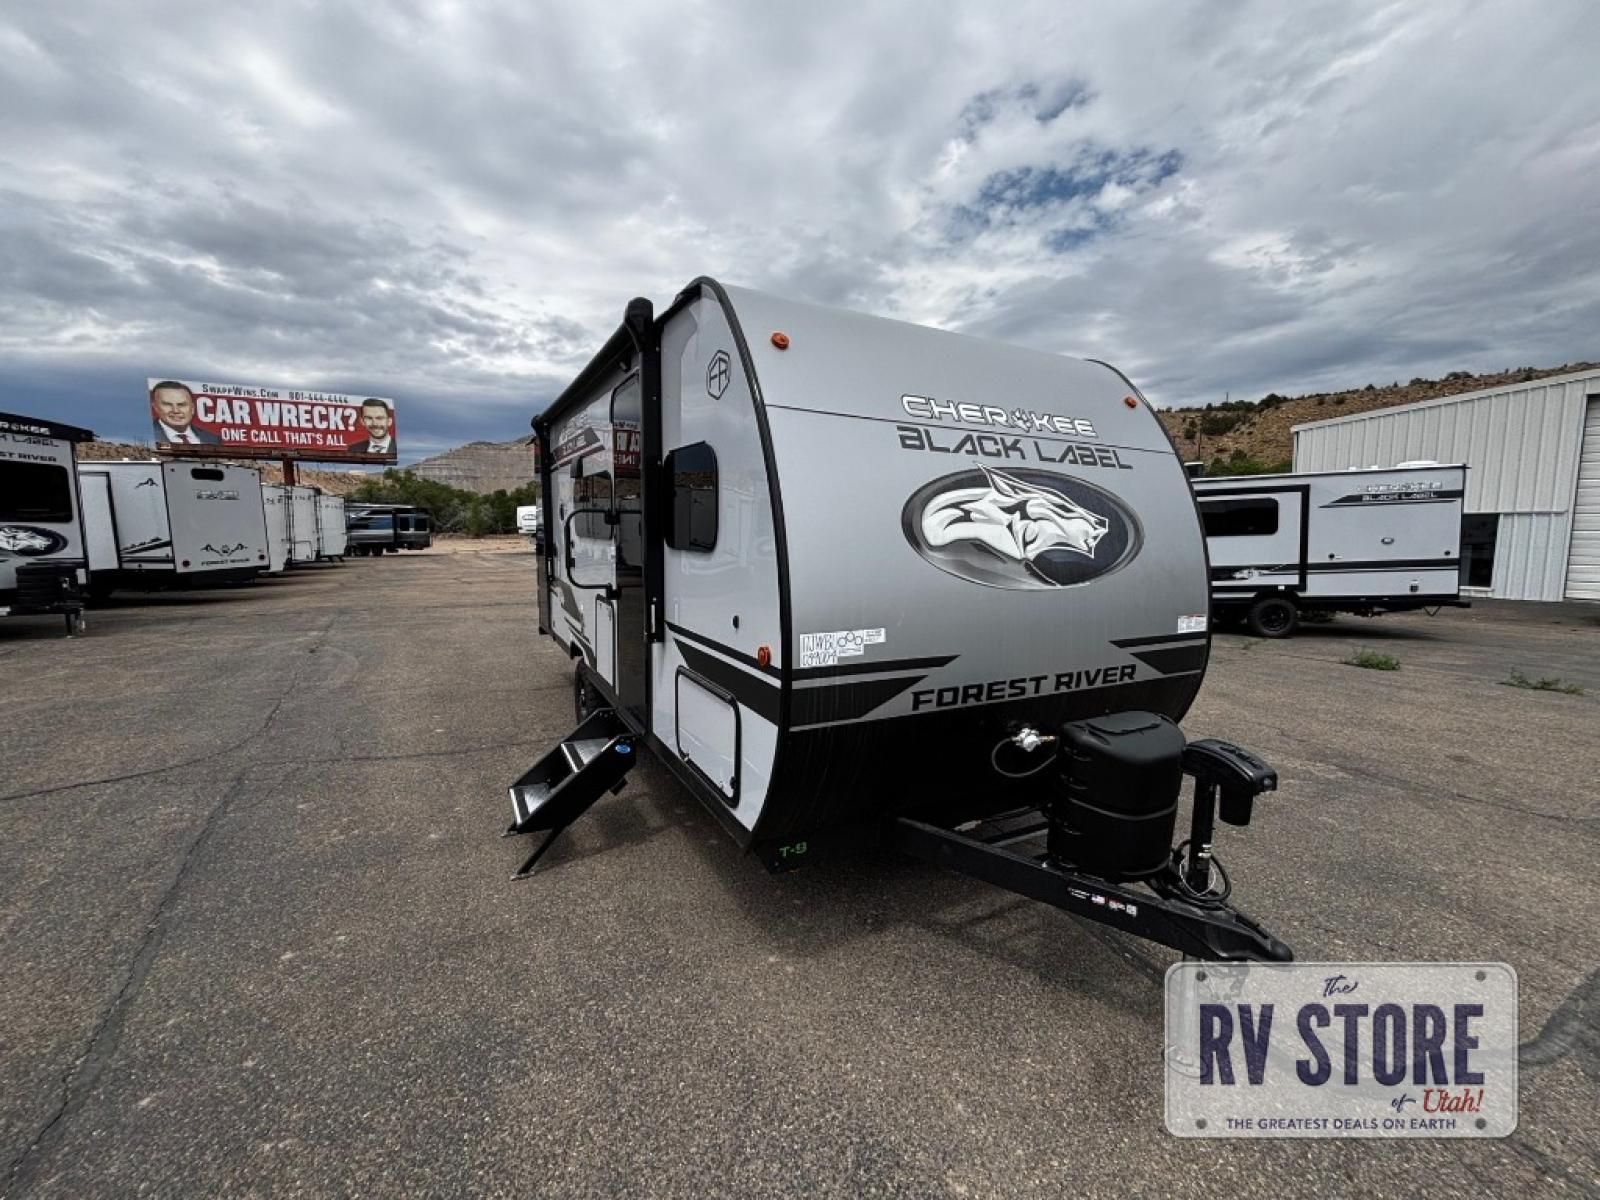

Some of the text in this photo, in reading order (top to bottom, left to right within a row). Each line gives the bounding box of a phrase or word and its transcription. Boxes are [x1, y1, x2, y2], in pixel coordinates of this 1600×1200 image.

[196, 396, 357, 432] CAR WRECK?
[221, 428, 348, 446] ONE CALL THAT'S ALL
[897, 425, 1133, 470] BLACK LABEL
[911, 664, 1137, 712] FOREST RIVER
